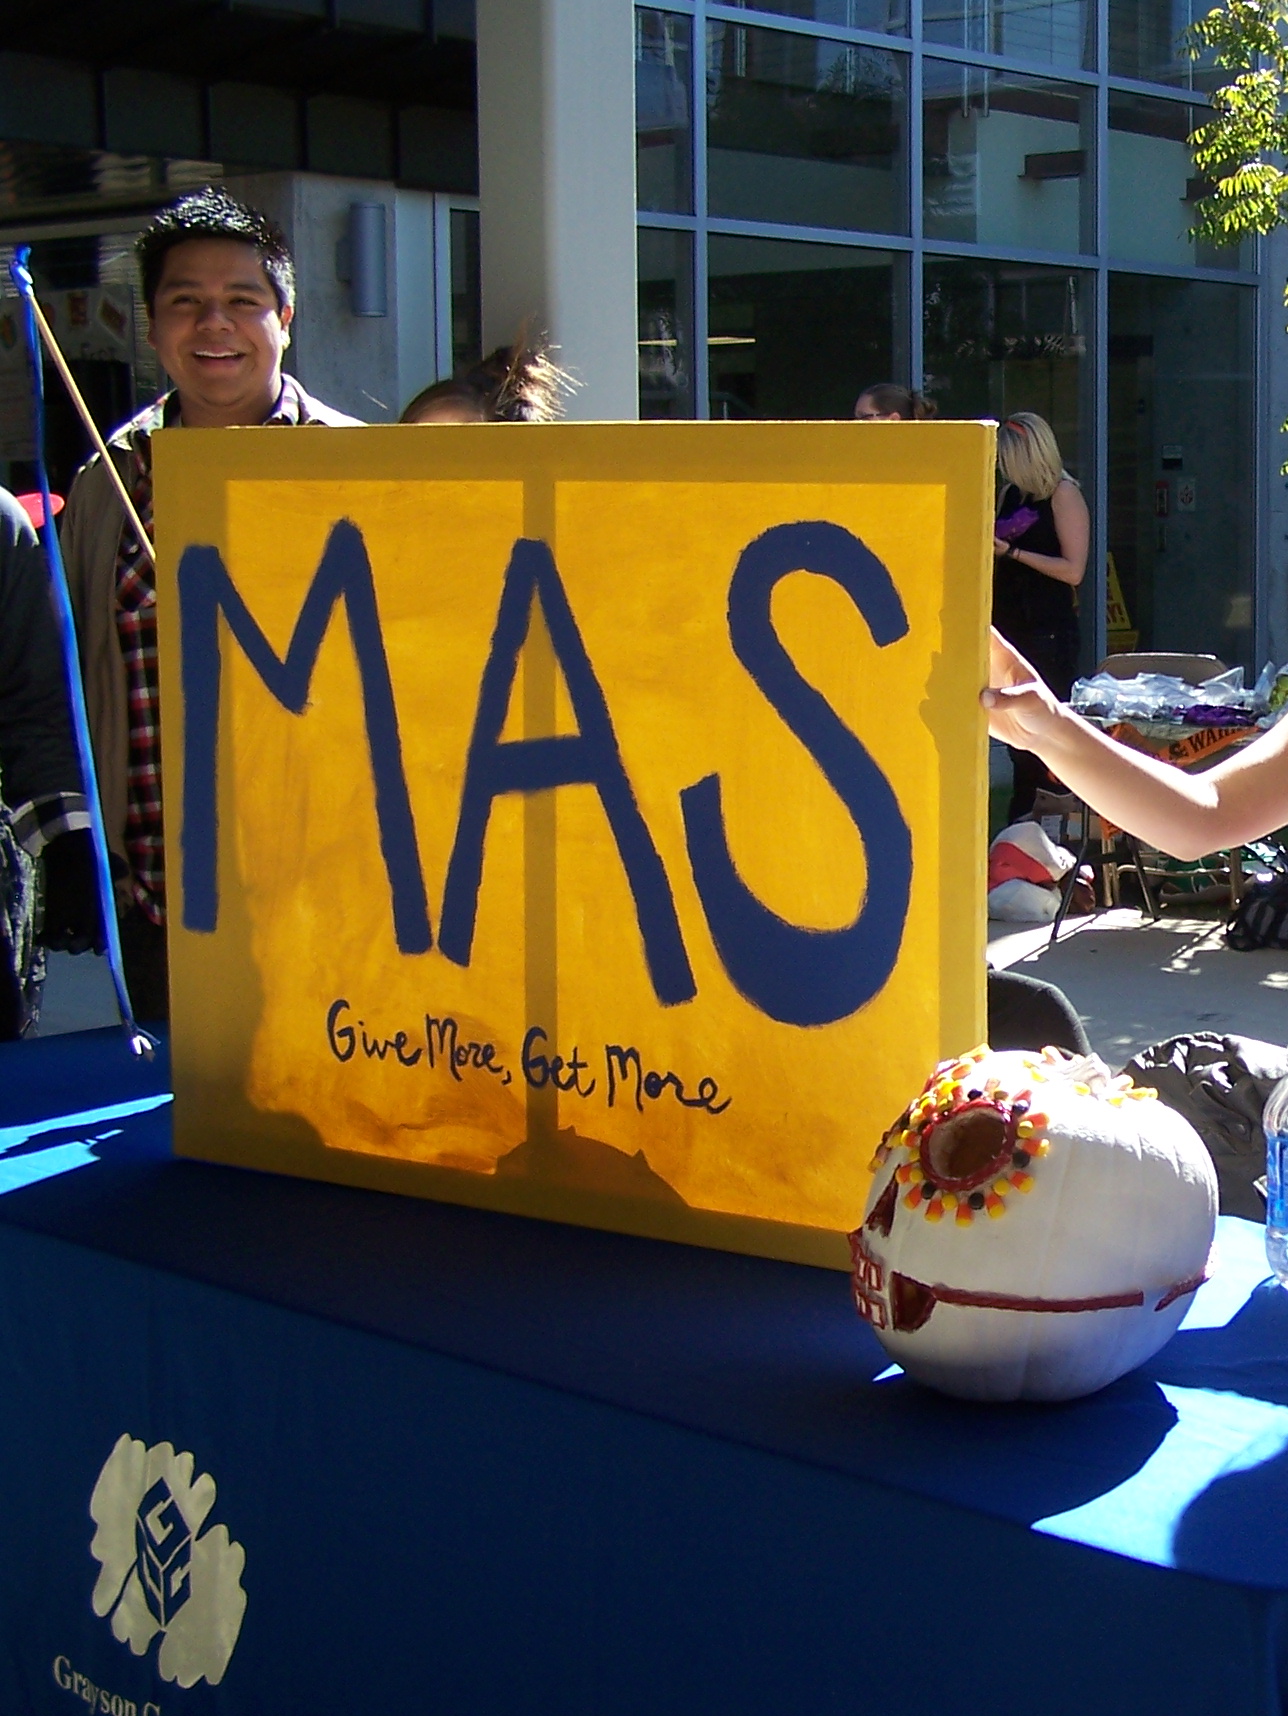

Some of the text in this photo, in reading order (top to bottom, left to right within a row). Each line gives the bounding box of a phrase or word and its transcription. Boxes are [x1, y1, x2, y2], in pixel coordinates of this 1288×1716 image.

[177, 518, 914, 1028] MAS
[327, 999, 732, 1115] Give More, Get More
[53, 1655, 138, 1716] Grayson
